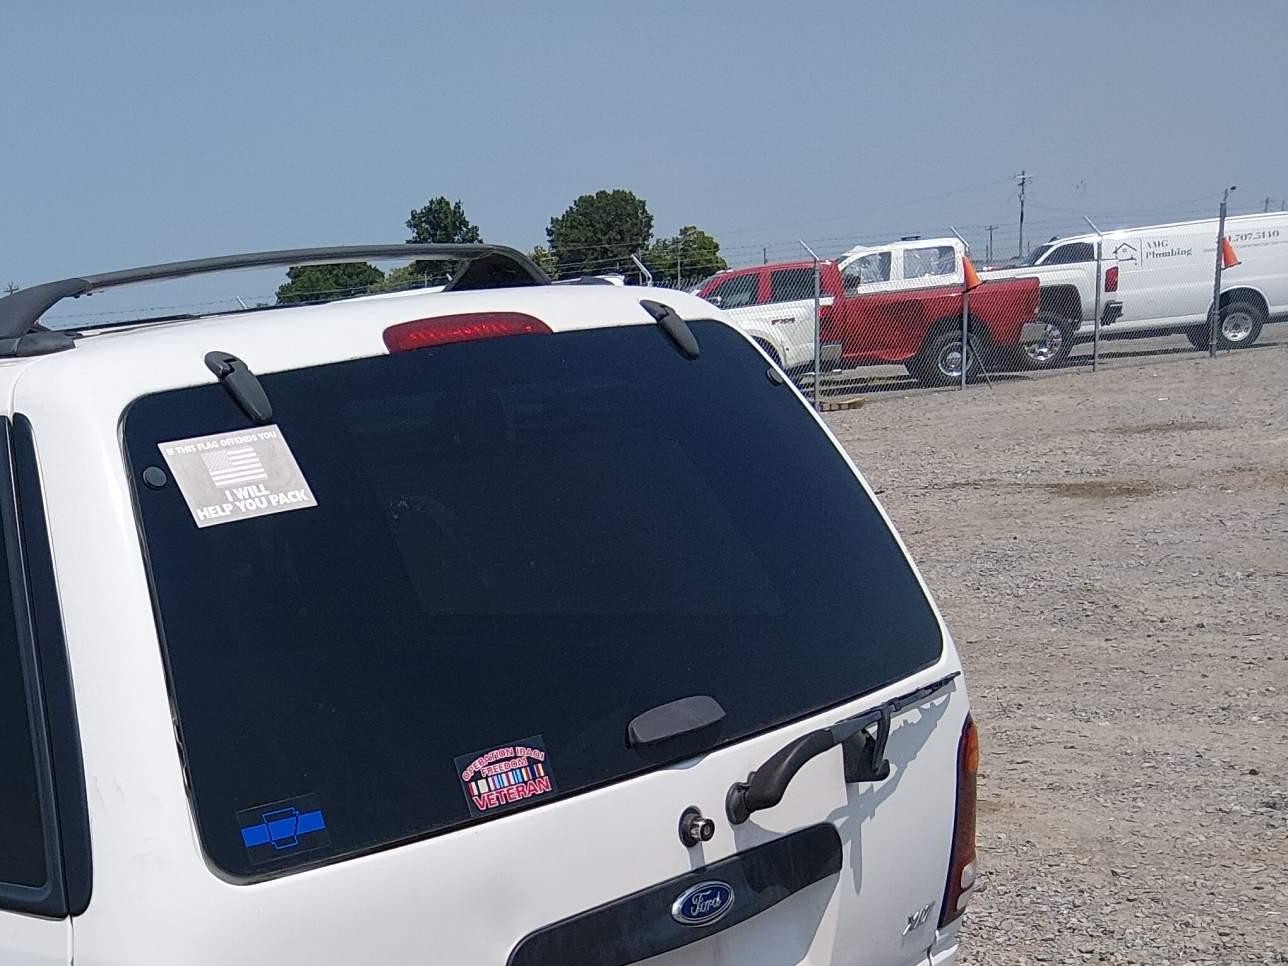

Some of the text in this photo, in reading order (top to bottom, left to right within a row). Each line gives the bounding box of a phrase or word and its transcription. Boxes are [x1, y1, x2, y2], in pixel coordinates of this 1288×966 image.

[1145, 247, 1193, 259] Plumbing
[165, 430, 277, 457] IF THIS FLAG OFFENDS YOU
[196, 488, 309, 521] HELP YOU PACK
[224, 483, 270, 503] I WILL
[461, 746, 545, 782] OPERATION IRAQI
[480, 756, 529, 778] FREEDOM
[472, 775, 552, 811] VETERAN
[691, 889, 722, 917] Ford
